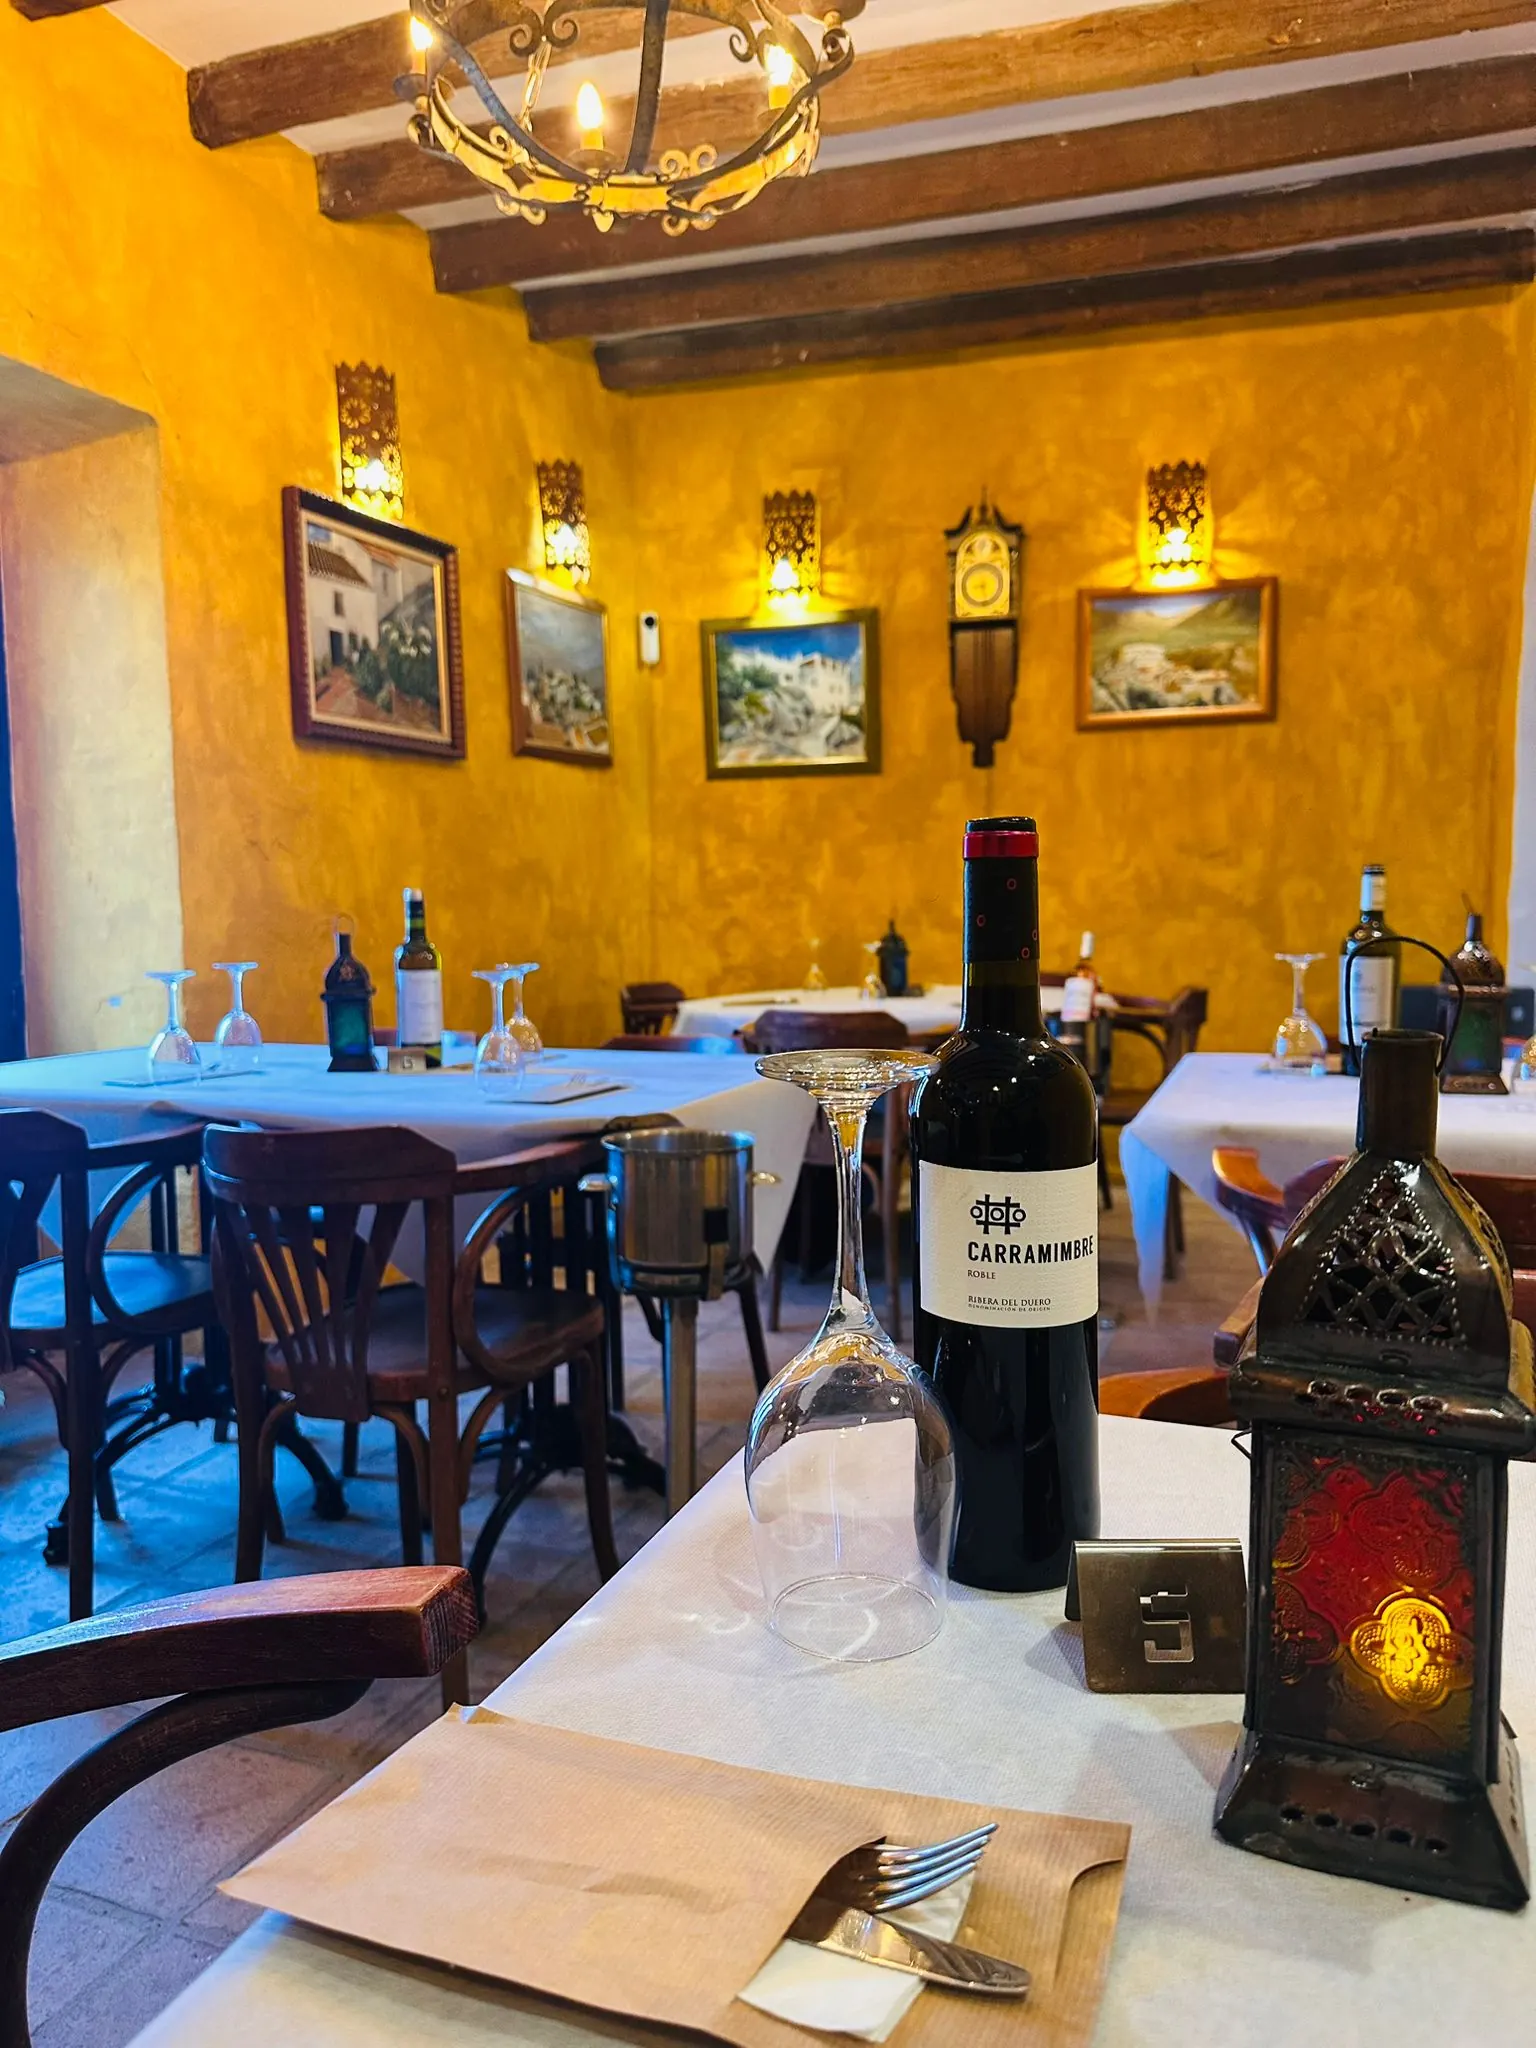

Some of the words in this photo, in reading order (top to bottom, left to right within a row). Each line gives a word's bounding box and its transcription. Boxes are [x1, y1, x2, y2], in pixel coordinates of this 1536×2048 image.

[968, 1236, 1094, 1264] CARRAMIMBRE
[967, 1269, 996, 1280] ROBLE
[968, 1295, 999, 1306] RIBERA
[1001, 1298, 1018, 1306] DEL
[1021, 1298, 1051, 1306] DUERO
